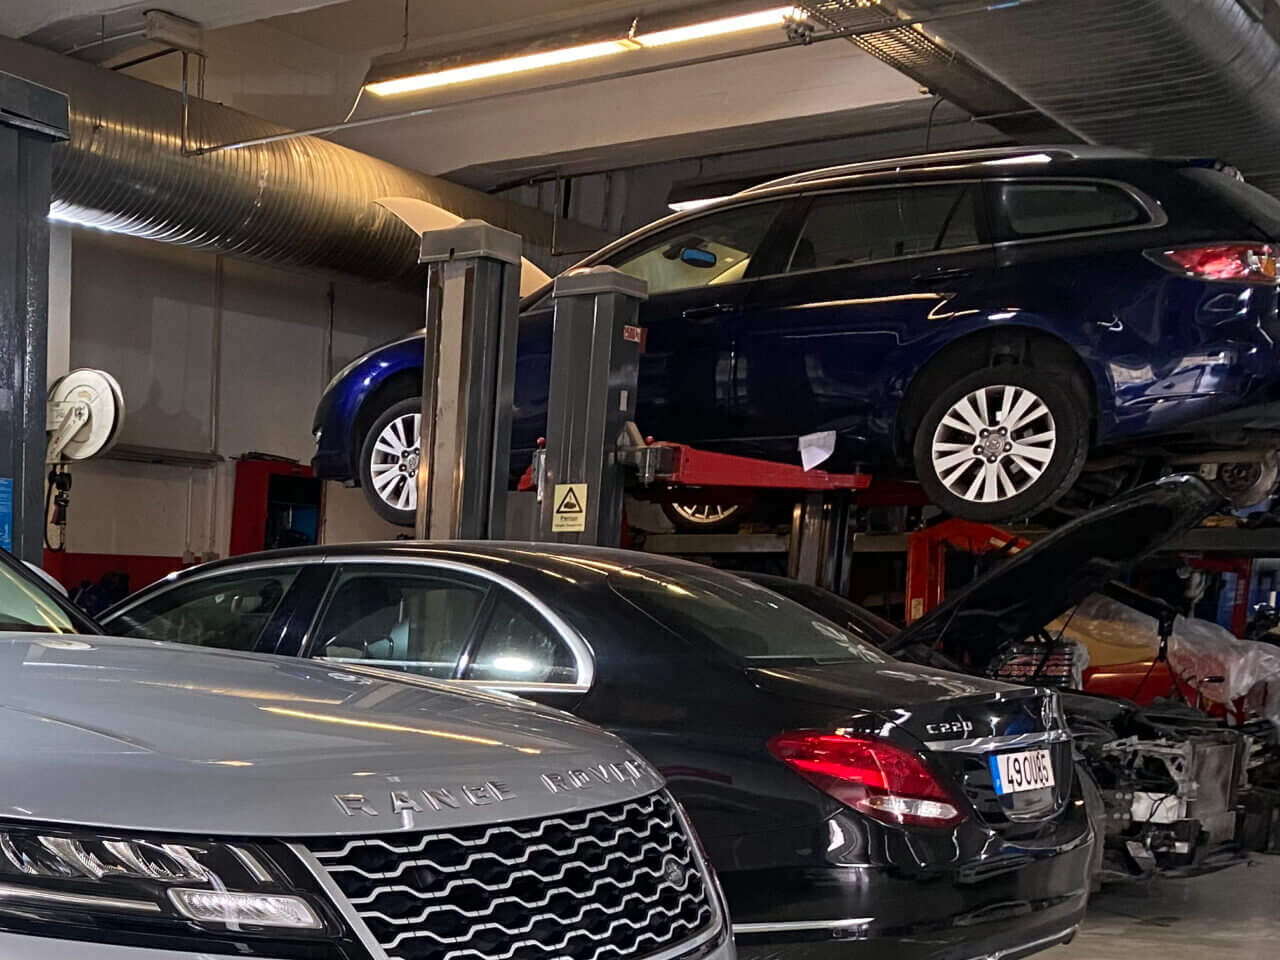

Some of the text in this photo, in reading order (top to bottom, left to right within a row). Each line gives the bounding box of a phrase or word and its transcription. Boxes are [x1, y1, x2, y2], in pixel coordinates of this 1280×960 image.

[926, 721, 974, 735] C220
[333, 759, 645, 817] RANGE ROVER
